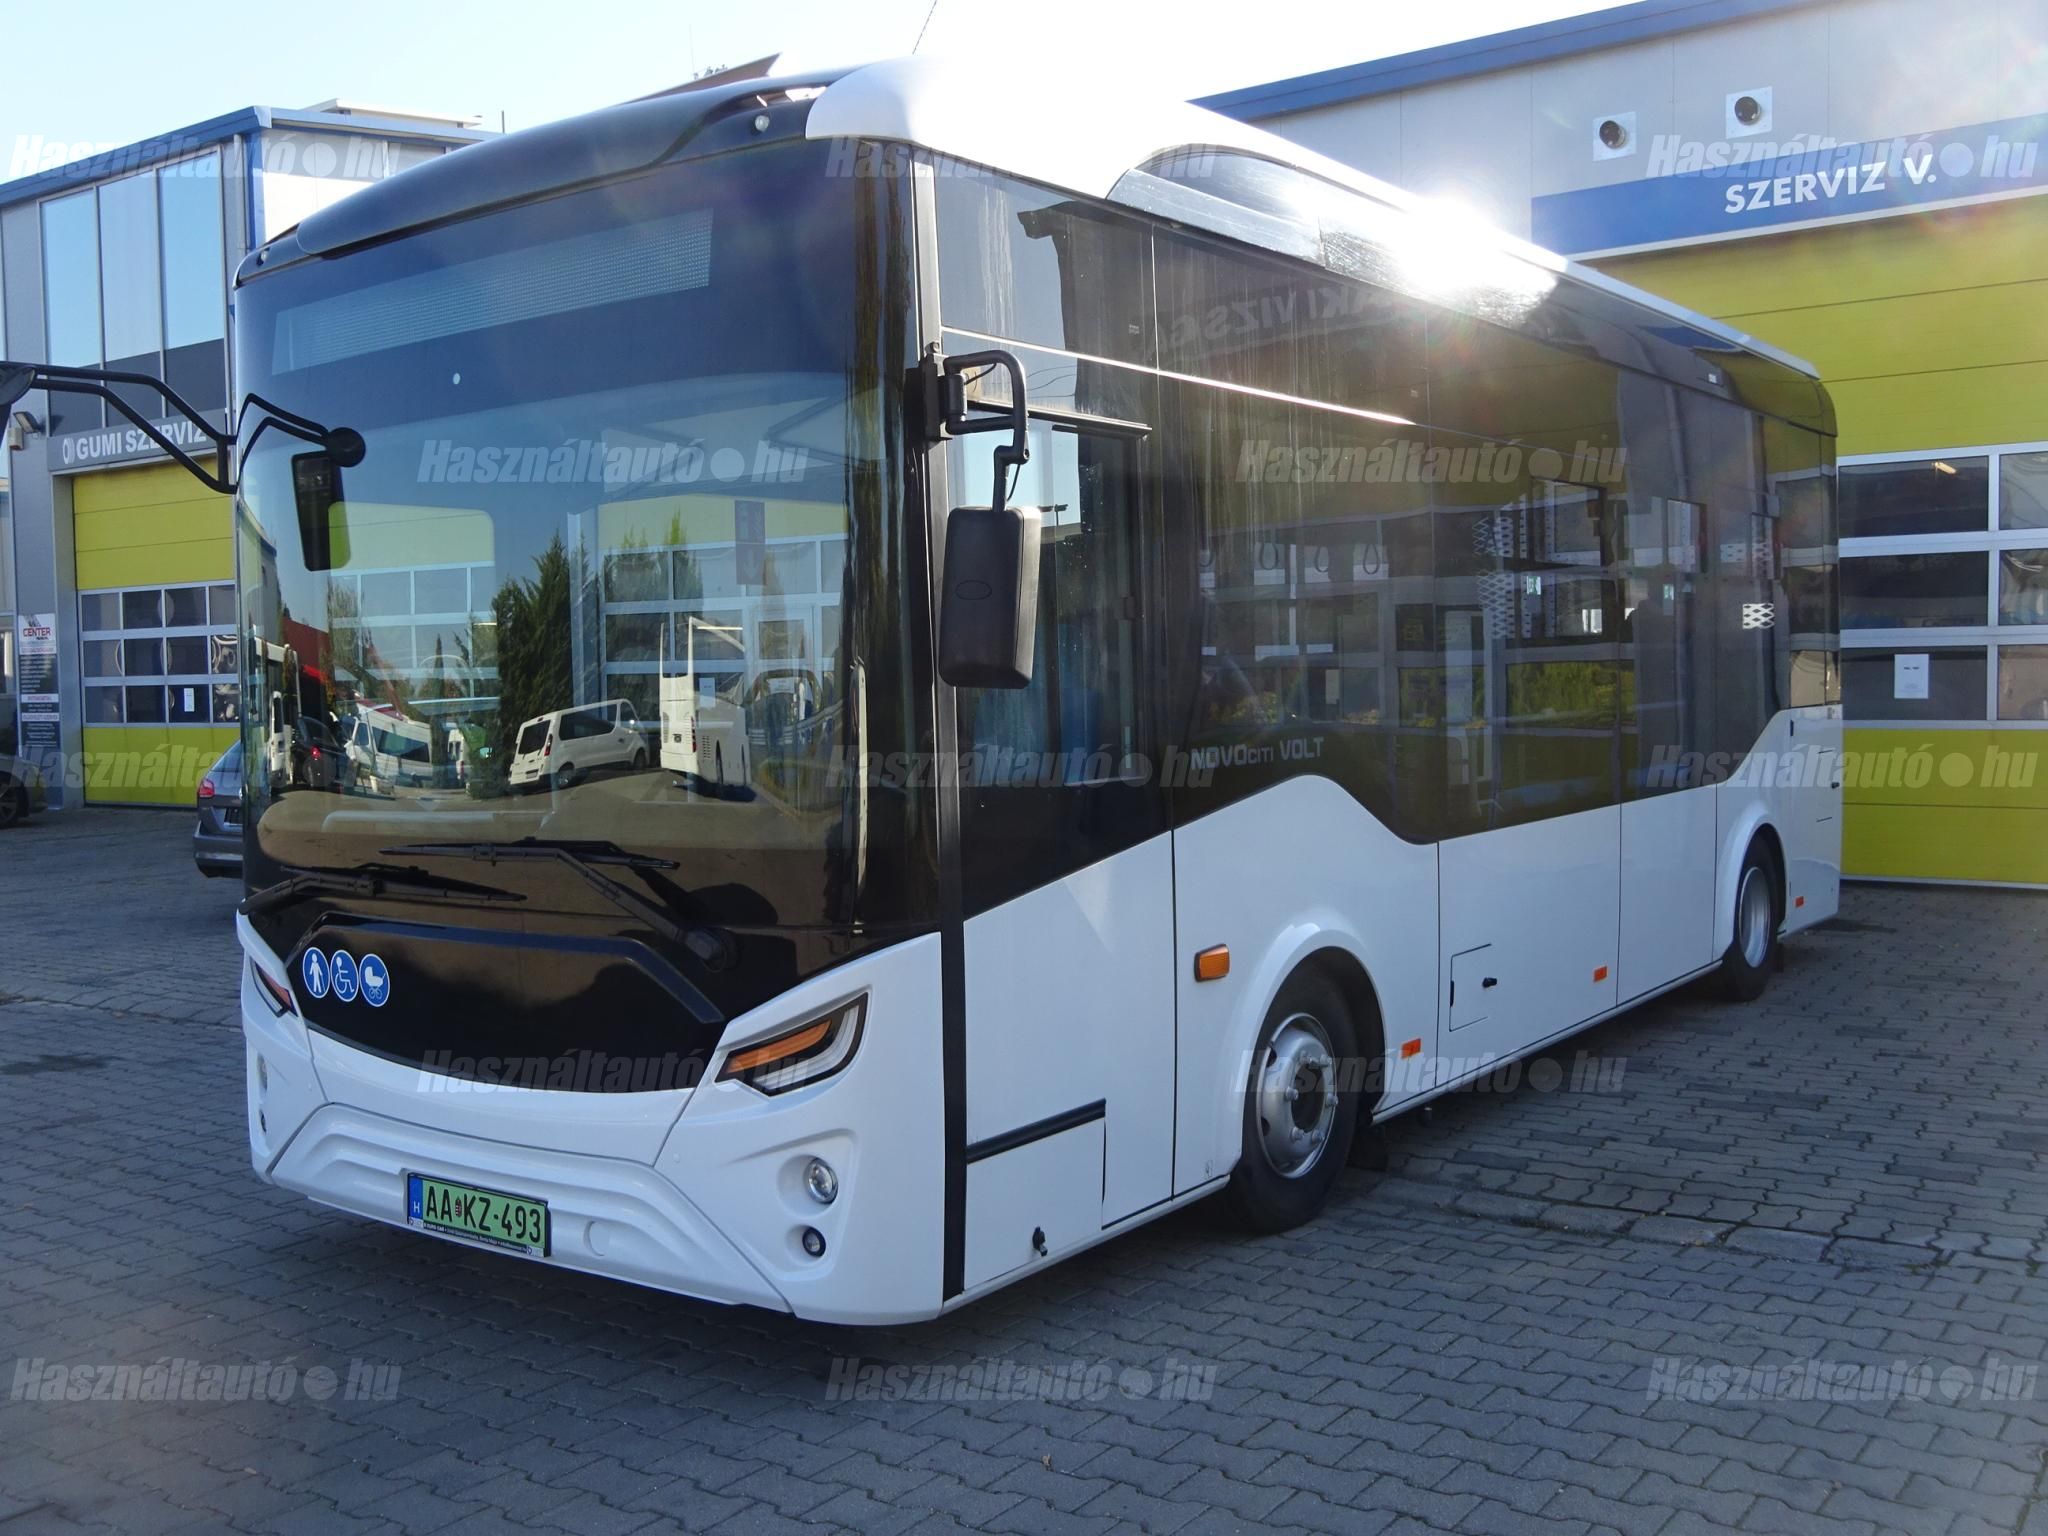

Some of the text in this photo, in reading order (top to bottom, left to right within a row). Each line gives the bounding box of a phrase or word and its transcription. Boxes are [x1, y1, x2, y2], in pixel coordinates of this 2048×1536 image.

[1724, 154, 1937, 214] SZERVIZ V.
[76, 432, 122, 460] GUMI
[22, 627, 51, 637] CENTER
[1280, 737, 1324, 760] VOLT
[413, 1201, 420, 1214] H
